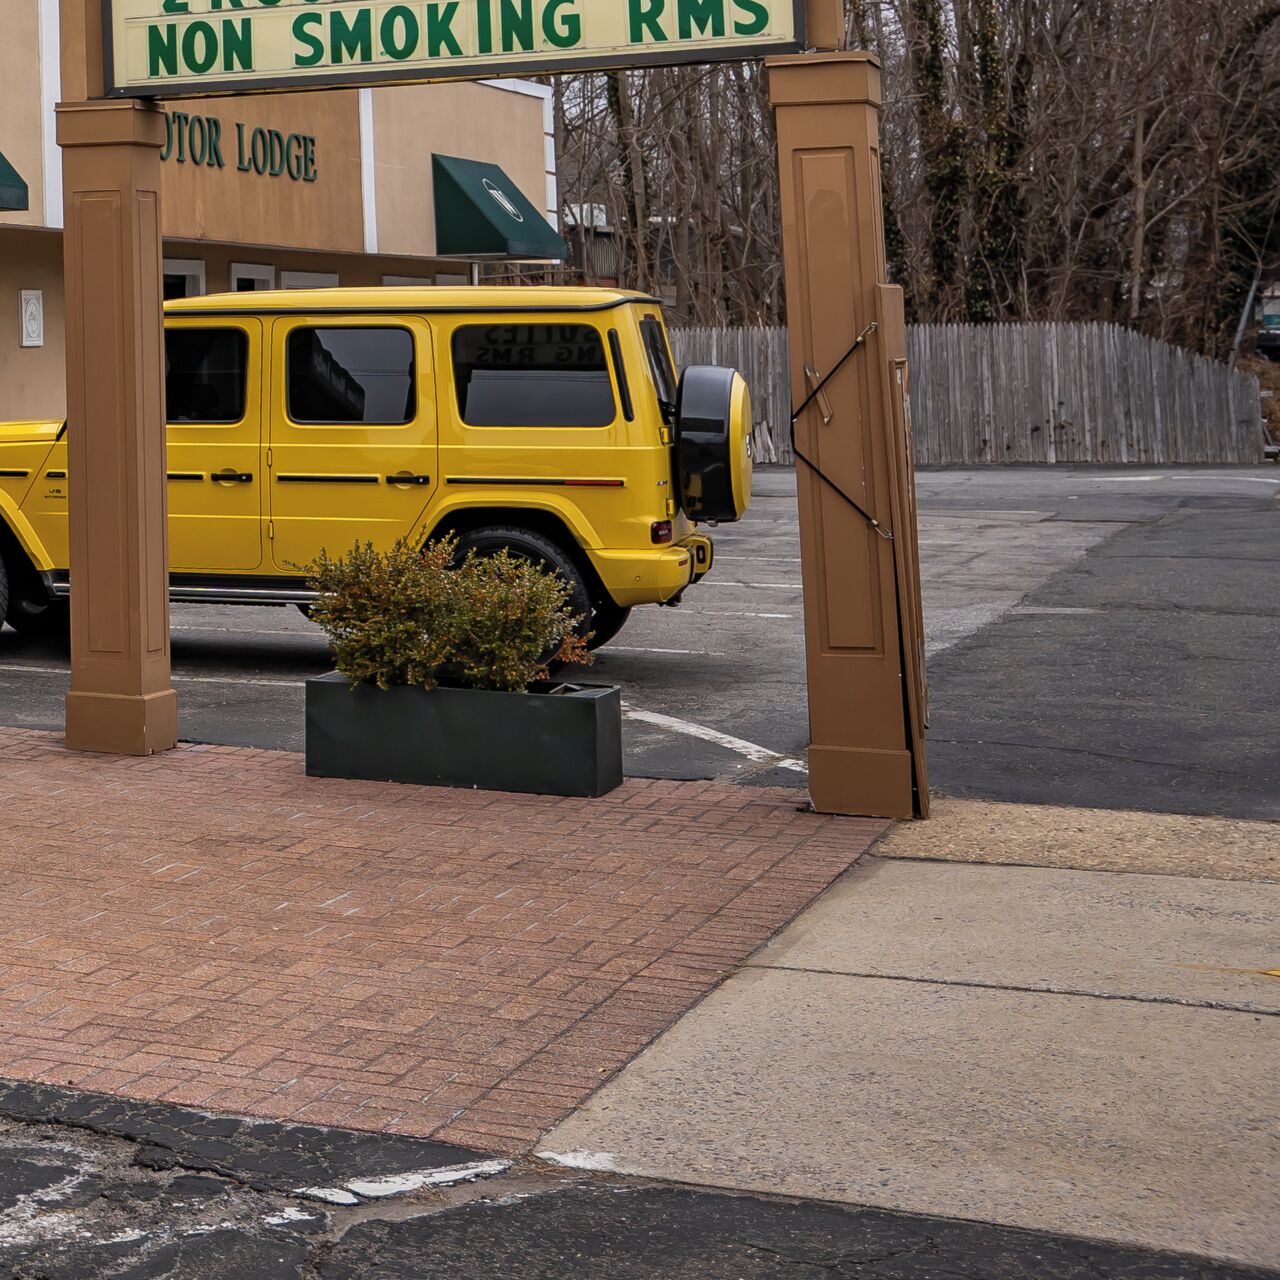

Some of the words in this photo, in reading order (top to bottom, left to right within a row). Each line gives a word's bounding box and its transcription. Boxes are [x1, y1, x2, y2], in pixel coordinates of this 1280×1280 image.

[147, 16, 254, 77] NON
[160, 111, 225, 168] OTOR
[235, 122, 317, 182] LODGE
